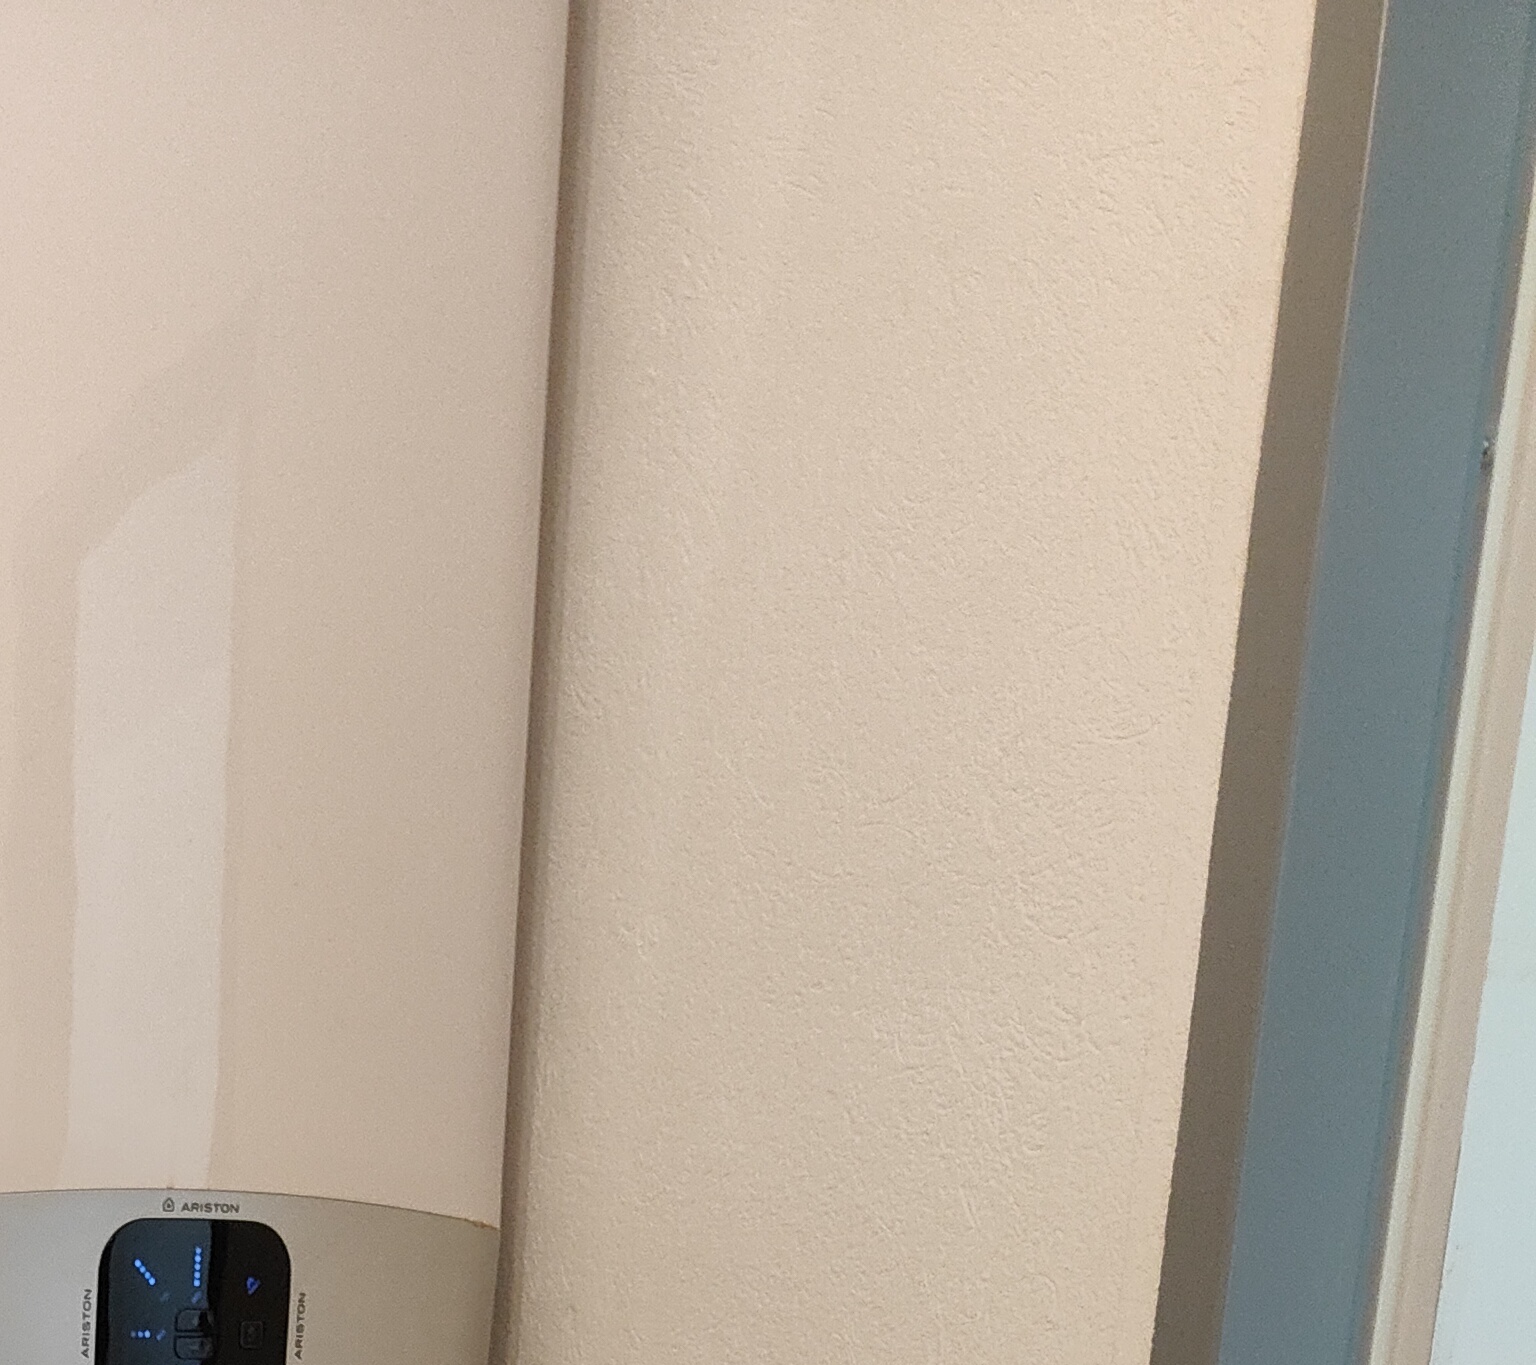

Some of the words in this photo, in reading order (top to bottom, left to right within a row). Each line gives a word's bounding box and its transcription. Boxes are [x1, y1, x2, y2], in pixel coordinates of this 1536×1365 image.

[181, 1202, 240, 1214] ARISTON
[81, 1289, 92, 1358] ARISTON
[294, 1293, 306, 1360] ARISTON
